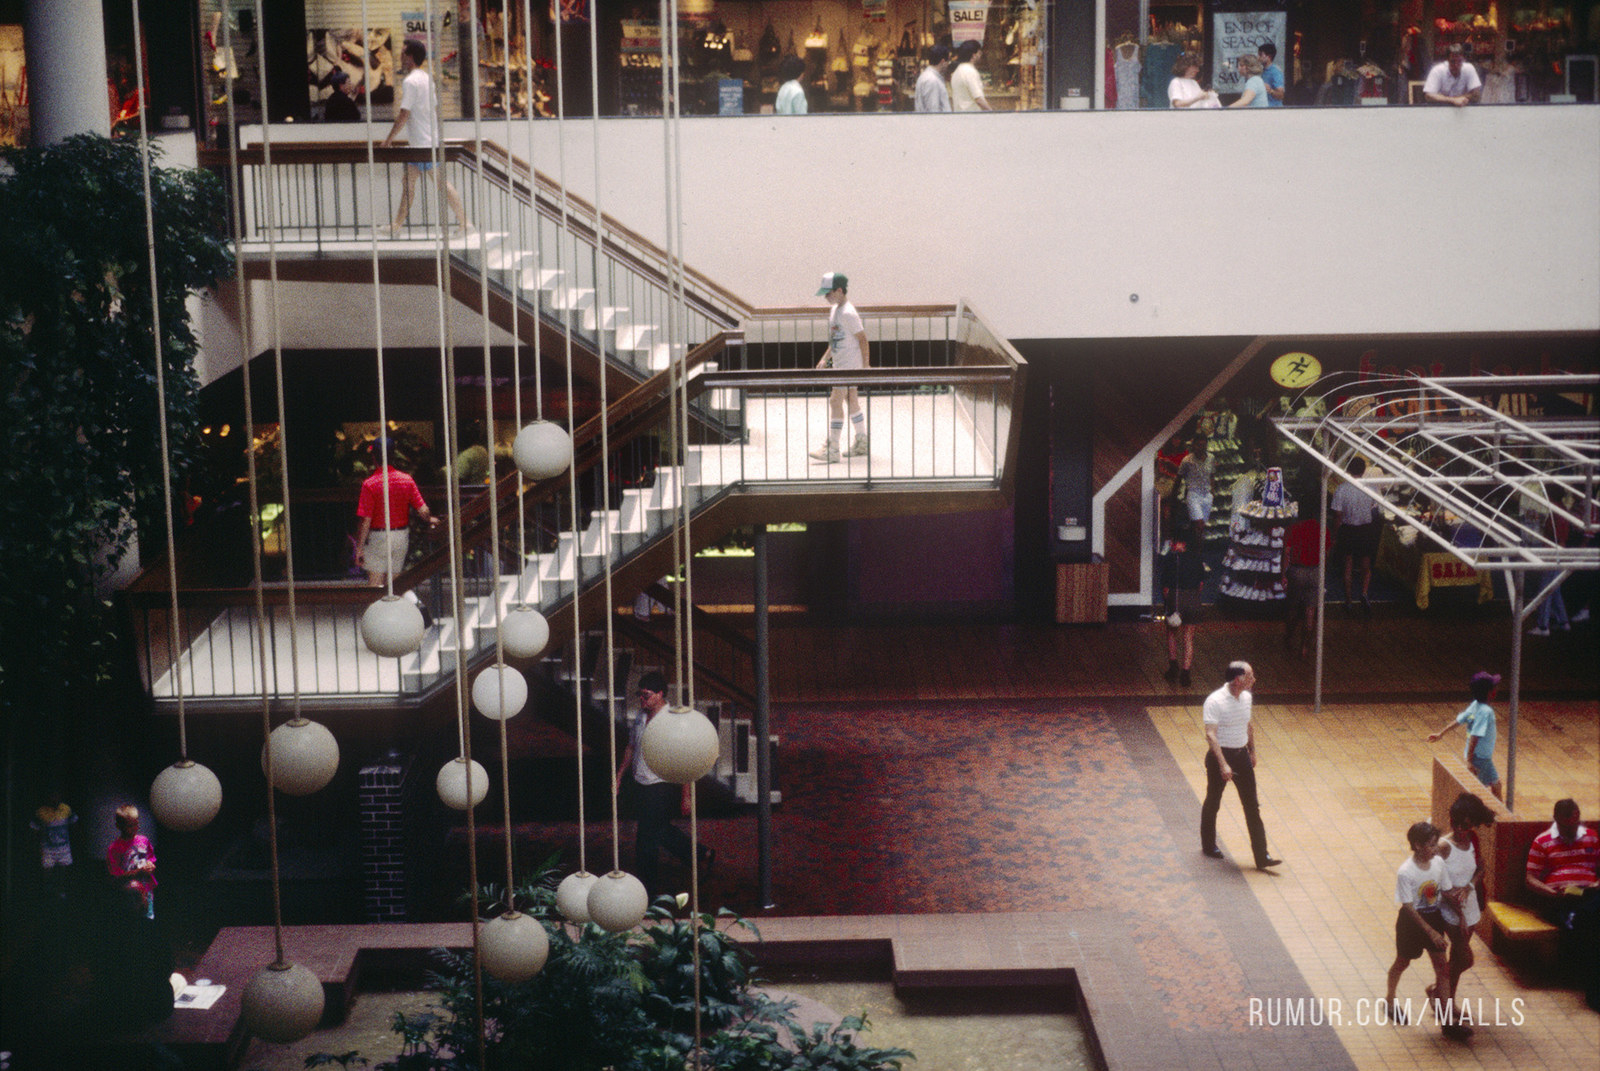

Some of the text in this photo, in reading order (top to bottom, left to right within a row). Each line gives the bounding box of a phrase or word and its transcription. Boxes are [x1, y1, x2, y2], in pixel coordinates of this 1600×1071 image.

[953, 10, 984, 22] SALE!
[1224, 21, 1274, 33] END OF
[1222, 35, 1277, 48] SEASON
